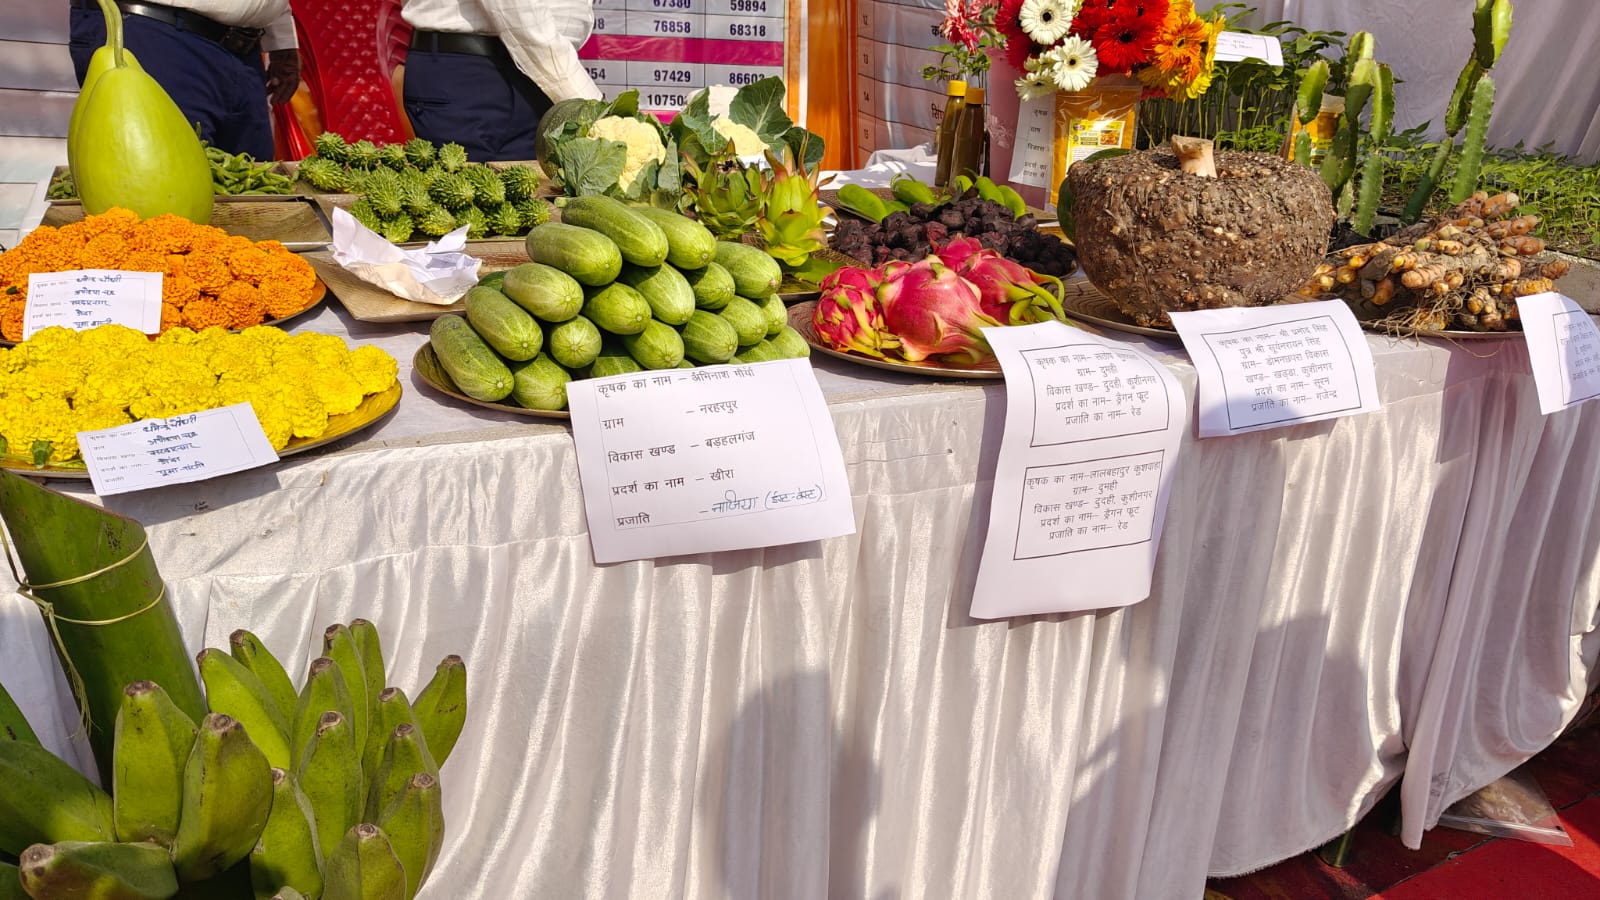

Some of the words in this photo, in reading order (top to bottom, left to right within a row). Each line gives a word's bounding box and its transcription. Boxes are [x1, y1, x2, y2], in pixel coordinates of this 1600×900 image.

[730, 0, 767, 12] 59894
[653, 20, 691, 33] 76858
[729, 24, 766, 37] 68318
[653, 70, 691, 82] 97429
[1216, 338, 1239, 349] कृषक
[1034, 357, 1057, 369] कृषक
[1058, 355, 1071, 364] का
[1305, 349, 1330, 360] विकास
[1301, 362, 1334, 377] कुशीनगर
[597, 381, 627, 398] कृषक
[633, 378, 647, 390] का
[652, 375, 672, 386] नाम
[1047, 384, 1072, 397] विकास
[1127, 375, 1157, 389] कुशीनगर
[1254, 385, 1273, 397] प्रदर्श
[1276, 383, 1287, 393] का
[1055, 399, 1074, 412] प्रदर्श
[1078, 398, 1088, 409] का
[1251, 398, 1276, 412] प्रजाति
[1279, 398, 1289, 407] का
[602, 417, 624, 430] ग्राम
[699, 400, 739, 414] नरहरपुर
[1065, 411, 1089, 425] प्रजाति
[1093, 411, 1104, 421] का
[1131, 405, 1142, 417] रेड
[608, 448, 643, 464] विकास
[649, 443, 676, 458] खण्ड
[704, 430, 756, 449] बड़हलगंज
[612, 482, 638, 496] प्रदर्श
[644, 480, 659, 492] का
[665, 476, 685, 489] नाम
[709, 468, 735, 481] खीरा
[1026, 477, 1049, 490] कृषक
[1054, 475, 1065, 485] का
[1098, 480, 1118, 495] दुमही
[1034, 503, 1061, 515] विकास
[1120, 490, 1153, 506] कुशीनगर
[616, 512, 651, 527] प्रजाति
[1040, 516, 1061, 528] प्रदर्श
[1064, 515, 1075, 525] का
[1048, 527, 1075, 540] प्रजाति
[1077, 525, 1088, 536] का
[1118, 519, 1129, 531] रेड
